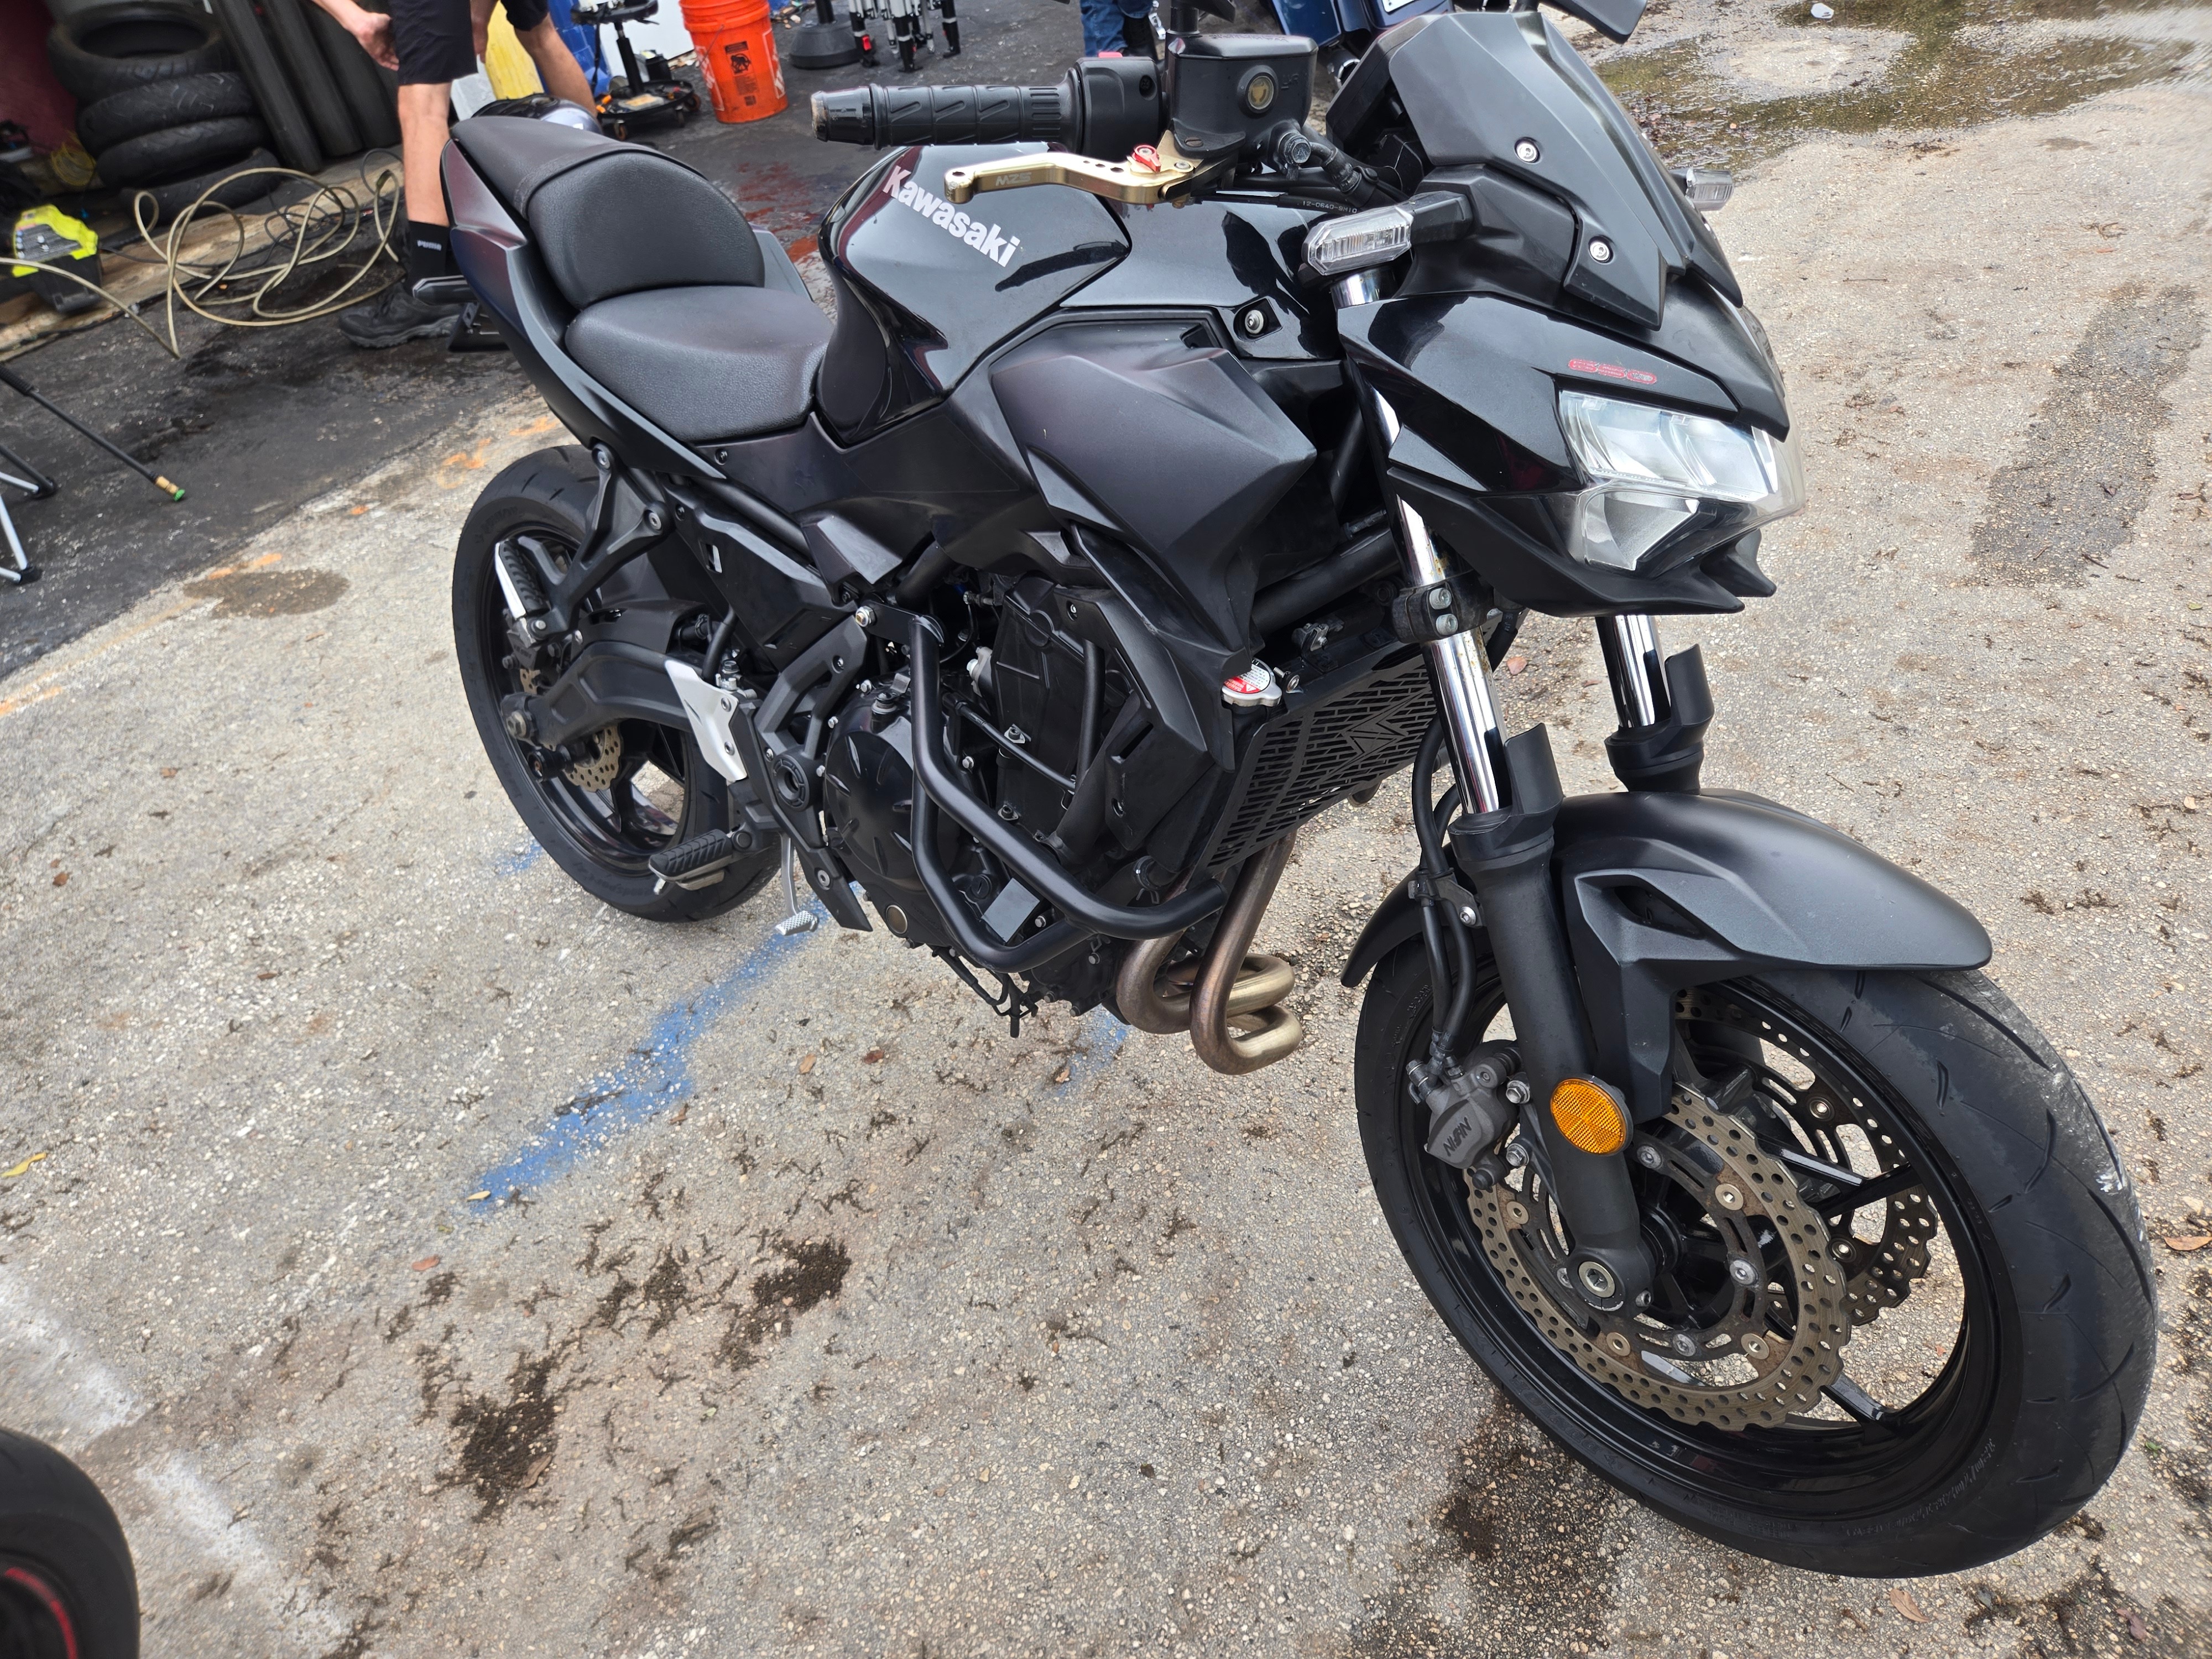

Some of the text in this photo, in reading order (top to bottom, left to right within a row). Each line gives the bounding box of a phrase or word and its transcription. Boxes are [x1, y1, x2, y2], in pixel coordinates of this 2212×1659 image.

[883, 165, 1020, 267] Kawasaki
[1568, 359, 1657, 384] 650
[1443, 1117, 1472, 1157] NISSIN
